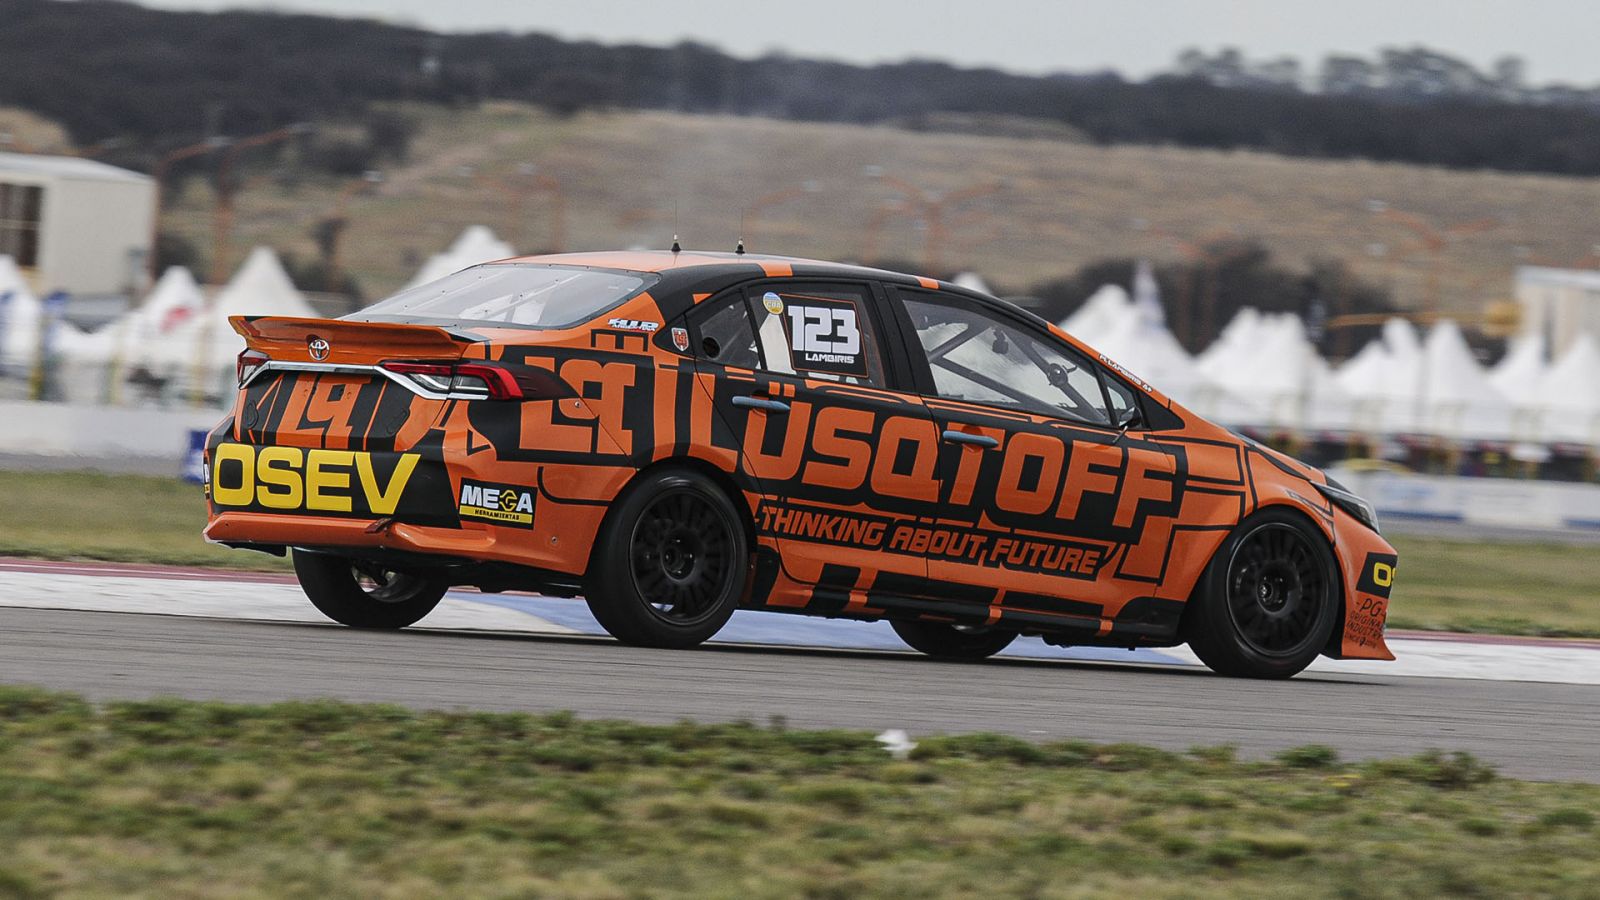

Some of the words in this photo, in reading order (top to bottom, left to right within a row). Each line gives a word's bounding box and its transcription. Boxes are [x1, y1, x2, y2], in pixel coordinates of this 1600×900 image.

[788, 305, 860, 355] 123
[805, 353, 855, 364] LAMBIRIS
[690, 372, 1177, 528] LÜSQTOFF
[213, 442, 421, 514] OSEV
[460, 484, 534, 513] MEGA
[761, 505, 888, 546] THINKING
[889, 526, 988, 559] ABOUT
[990, 538, 1101, 575] FUTURE
[1373, 562, 1396, 587] O
